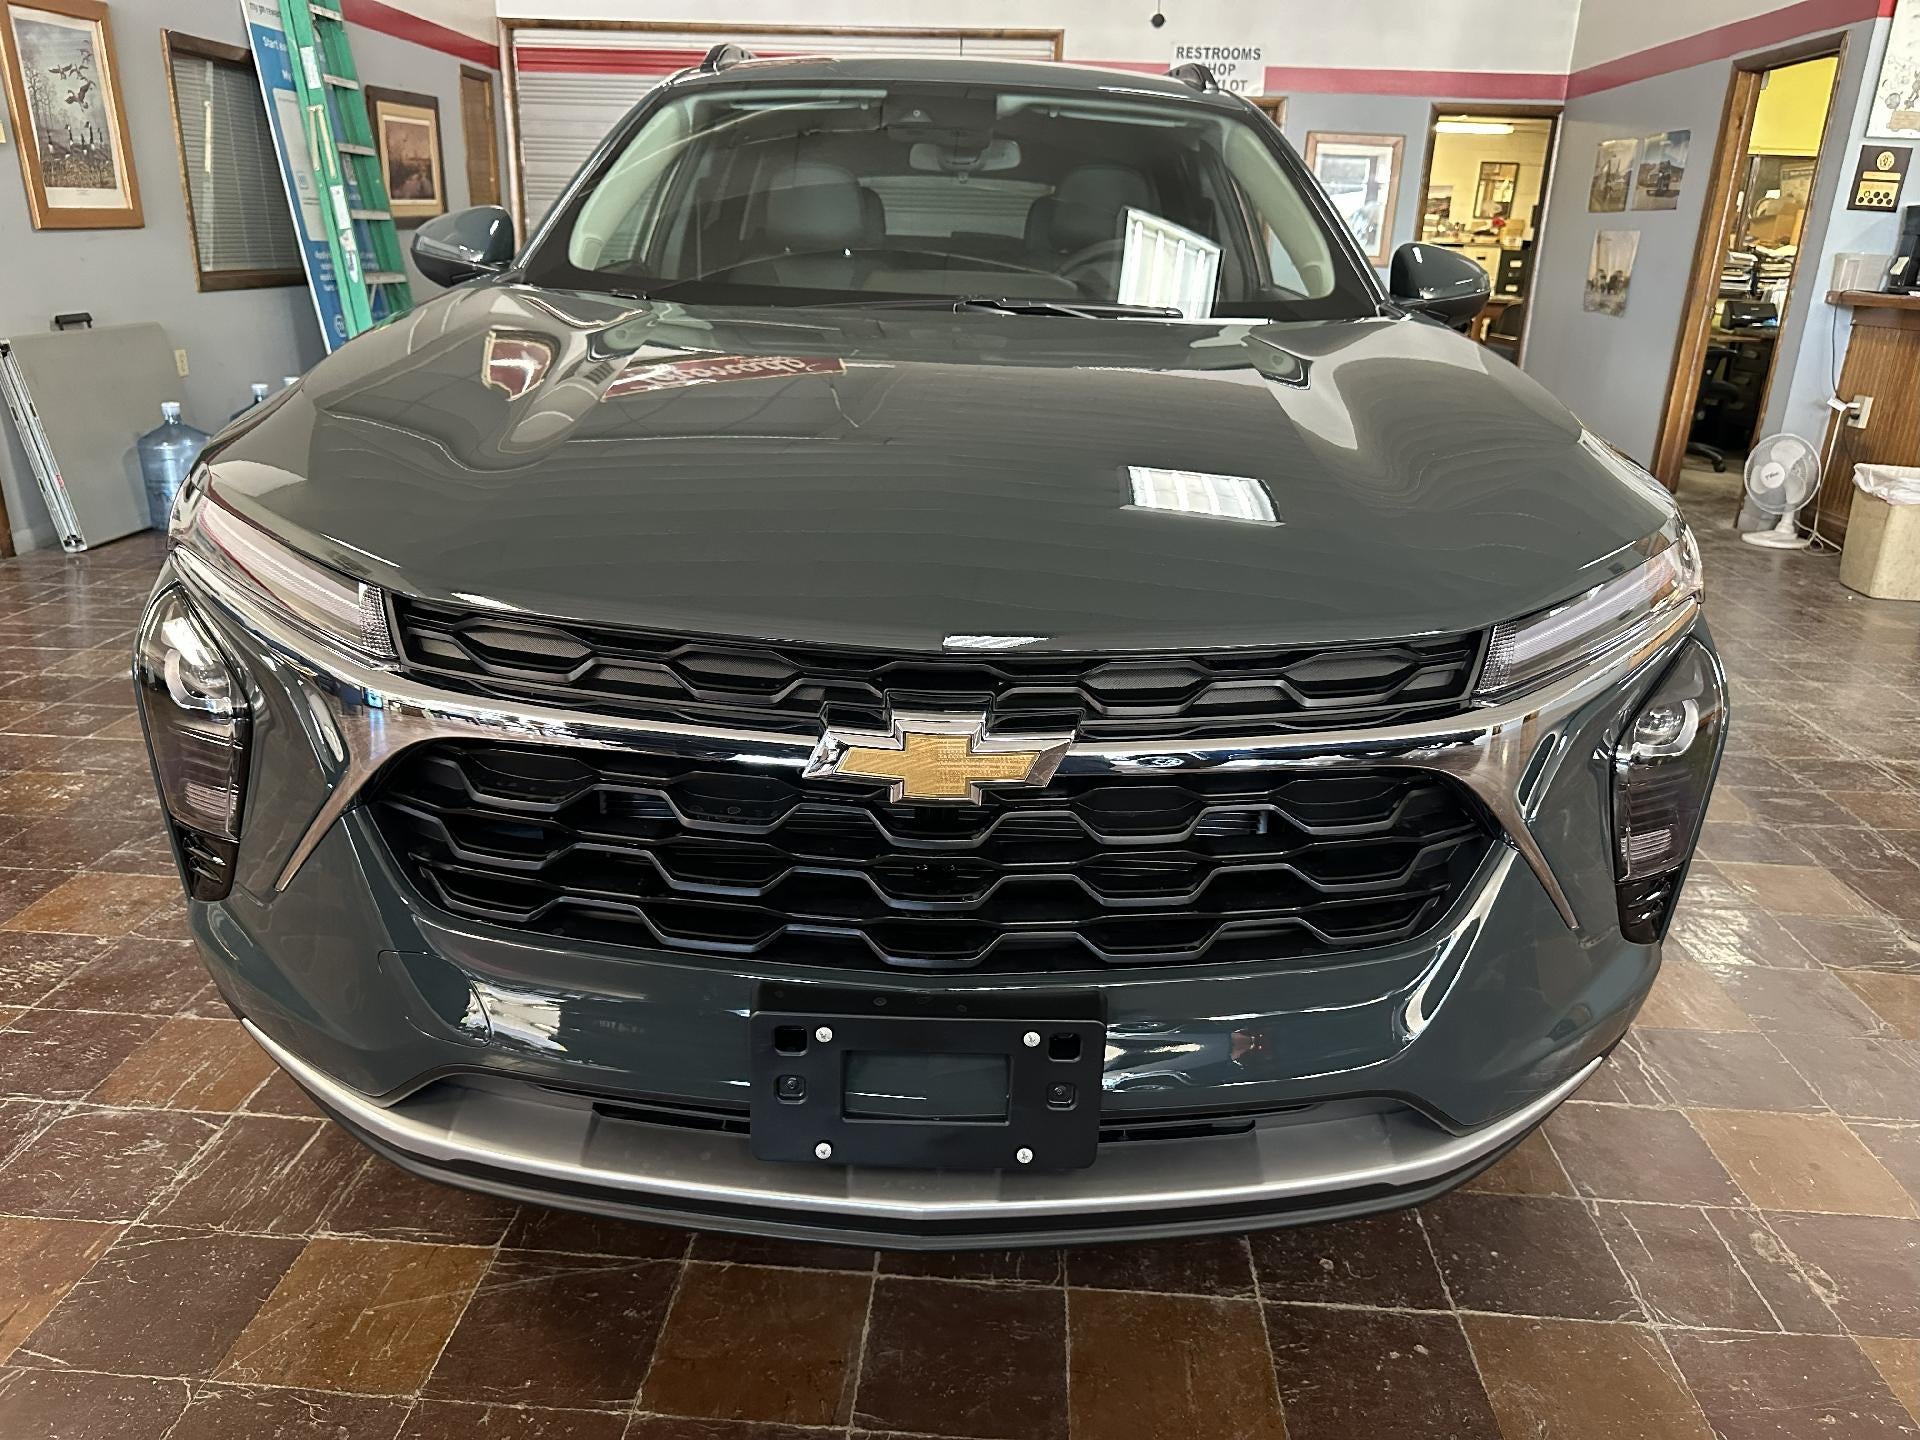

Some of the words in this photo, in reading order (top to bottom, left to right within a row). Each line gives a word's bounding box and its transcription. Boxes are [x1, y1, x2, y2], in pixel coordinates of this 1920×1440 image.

[1176, 46, 1261, 60] RESTROOMS
[1202, 63, 1236, 76] HOP
[1217, 80, 1247, 91] LOT
